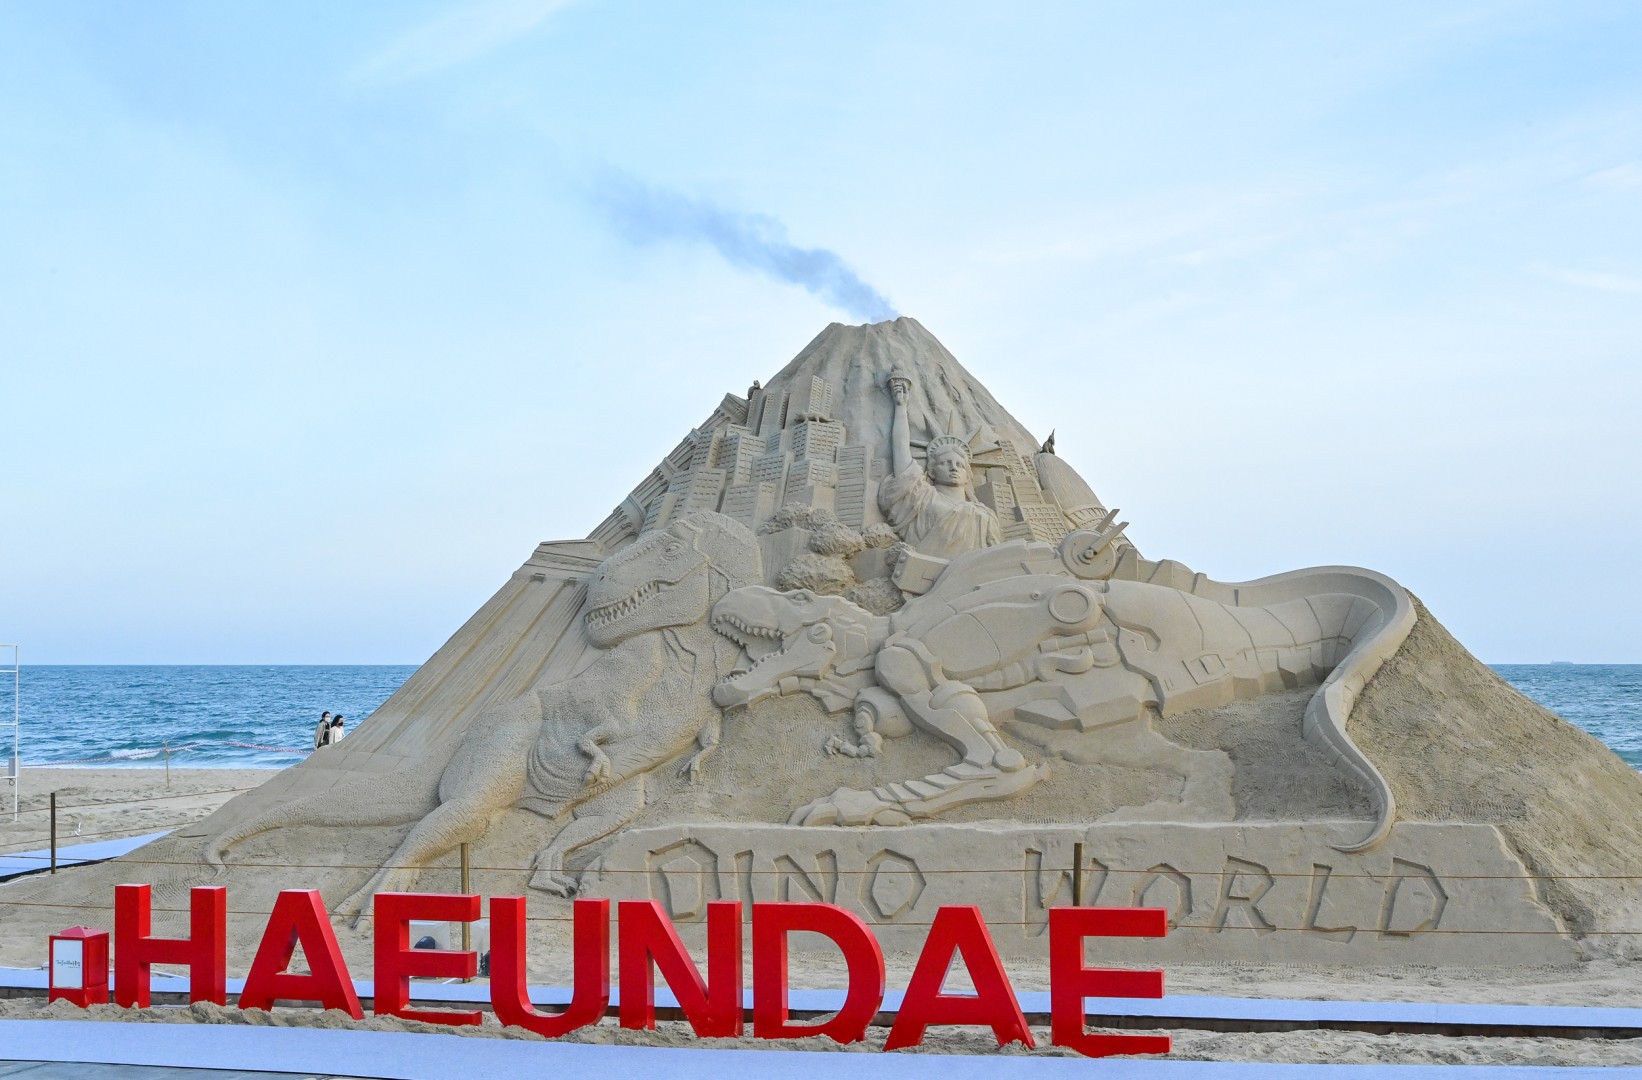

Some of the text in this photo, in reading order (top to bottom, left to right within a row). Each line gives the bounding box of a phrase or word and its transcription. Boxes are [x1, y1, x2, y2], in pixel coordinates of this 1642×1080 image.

[644, 837, 1448, 943] DINO WORLD
[115, 883, 1172, 1058] HAEUNDAE
